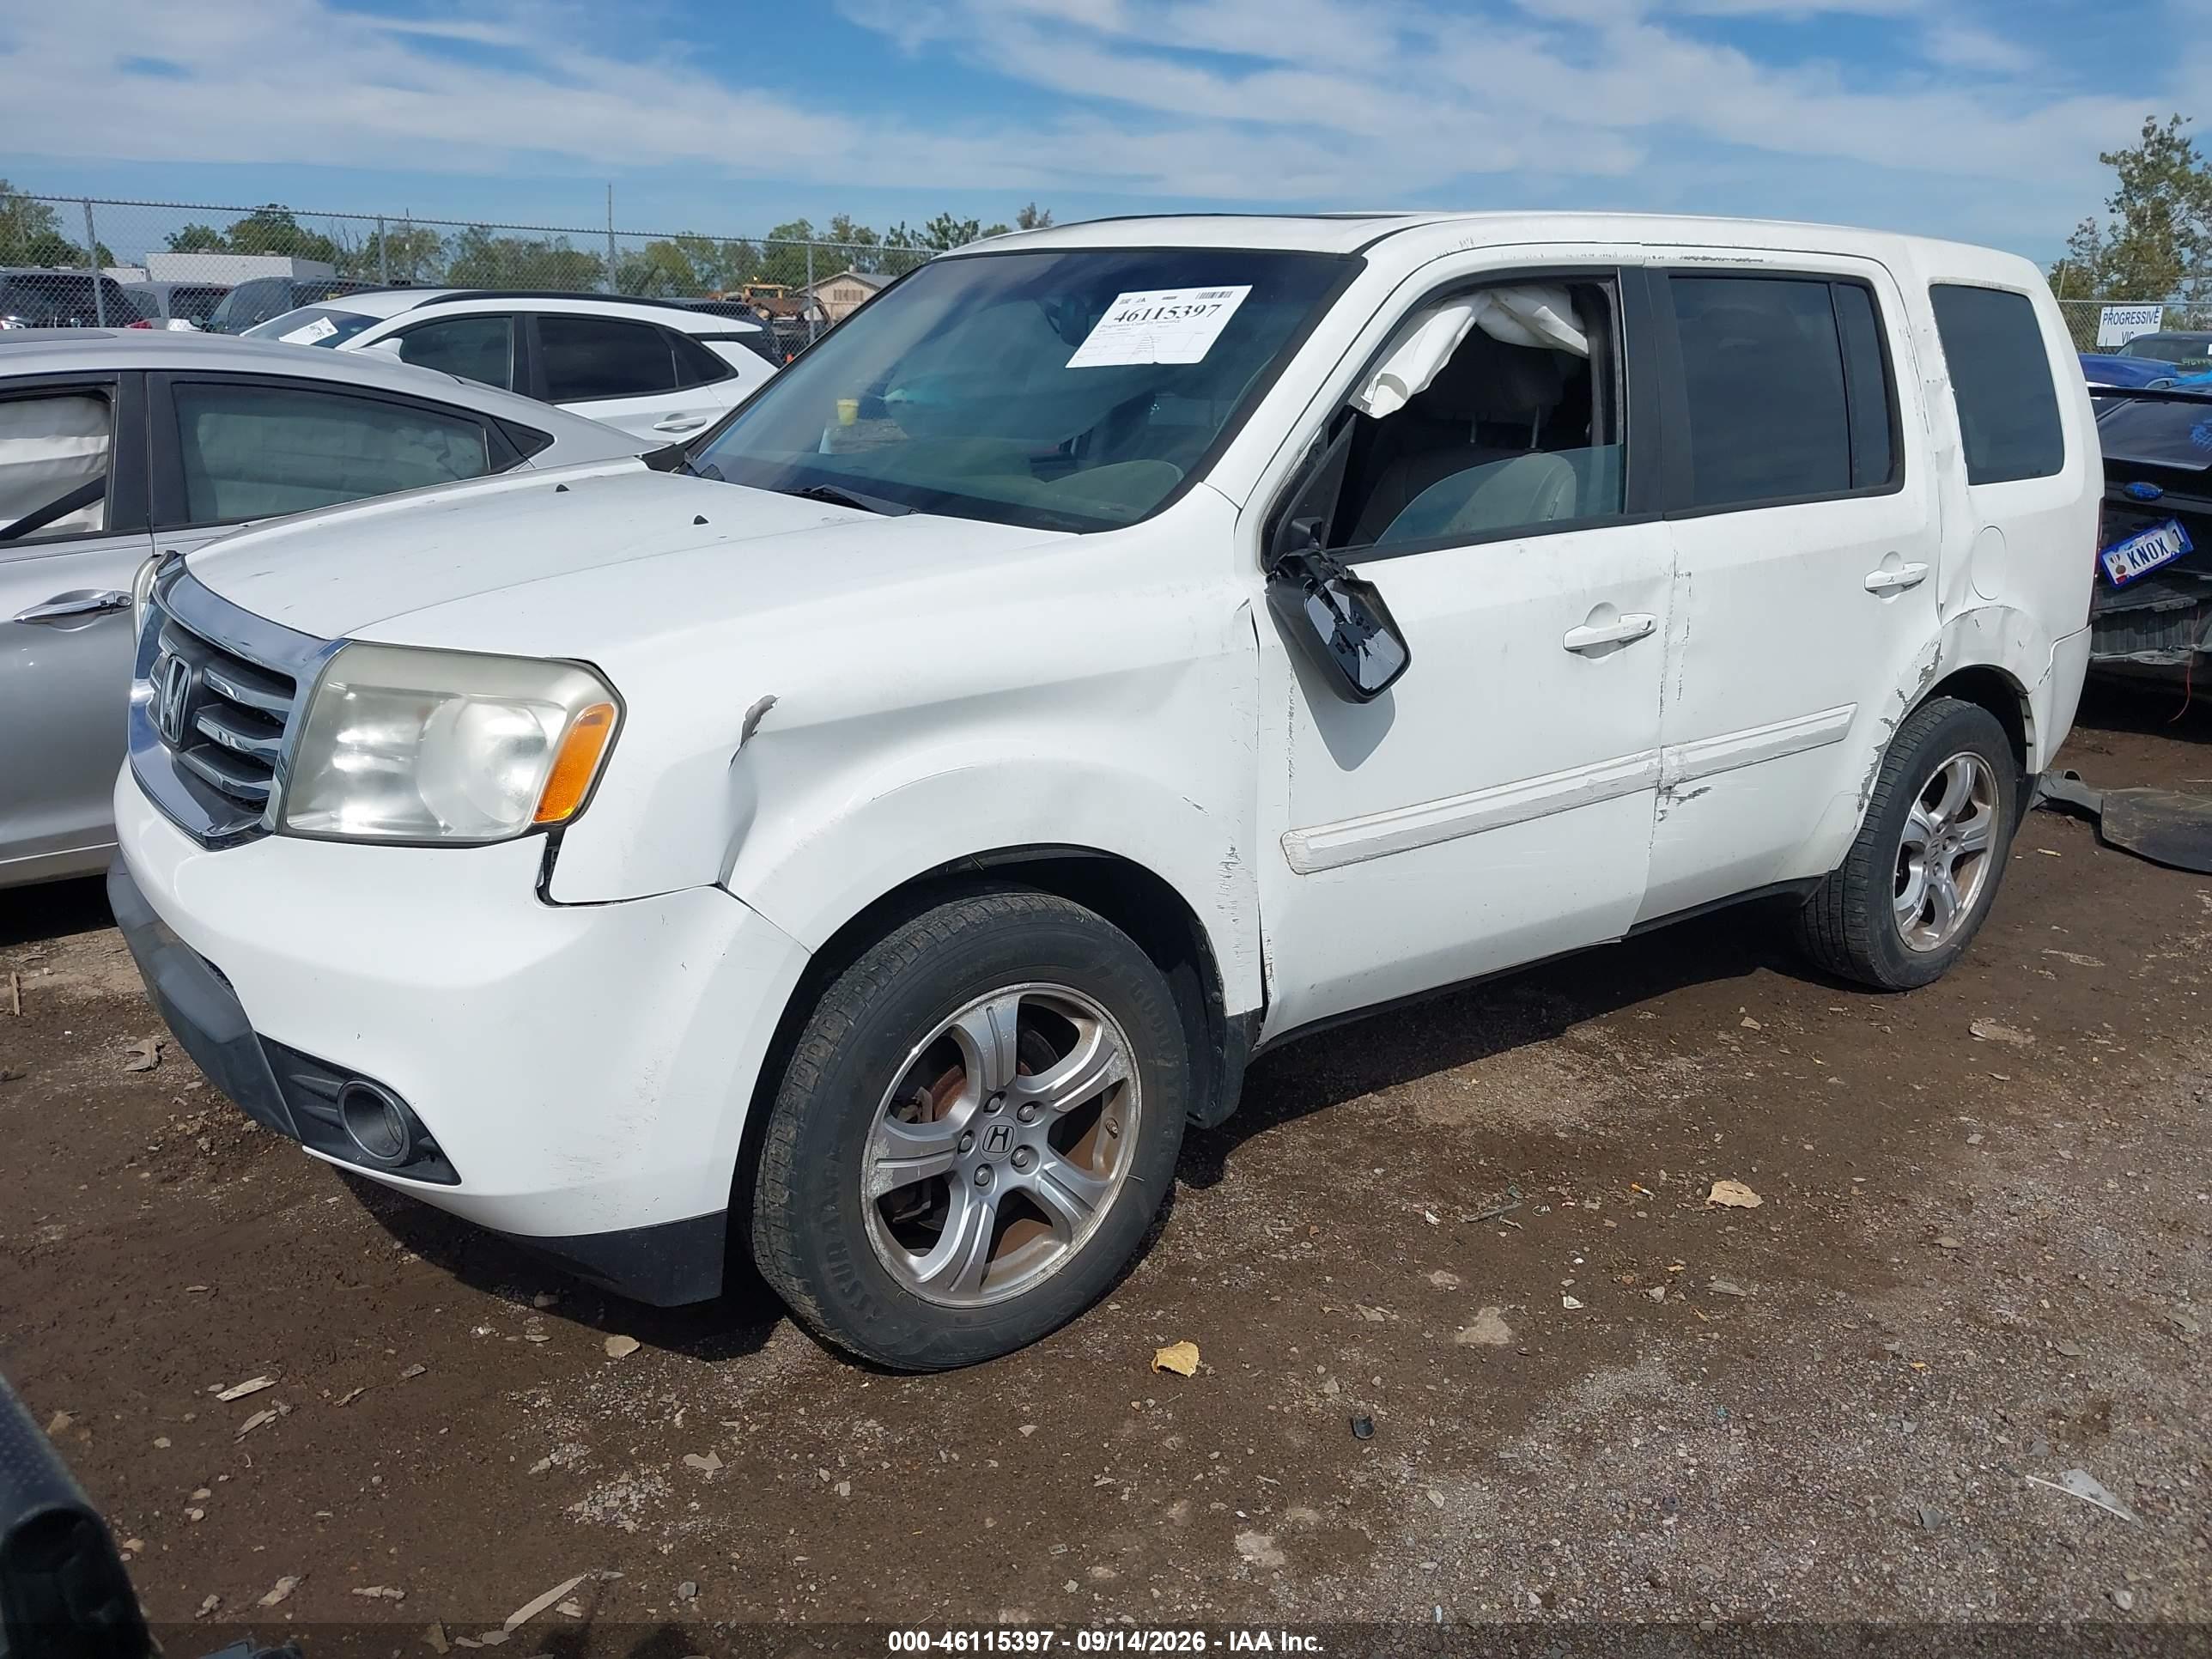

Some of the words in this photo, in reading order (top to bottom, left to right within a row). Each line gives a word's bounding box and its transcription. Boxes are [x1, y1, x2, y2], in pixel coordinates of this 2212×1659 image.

[1114, 304, 1223, 323] 46115397
[2102, 311, 2160, 325] PROGRESSIVE
[2127, 537, 2169, 569] KNOX
[2172, 529, 2185, 547] 1
